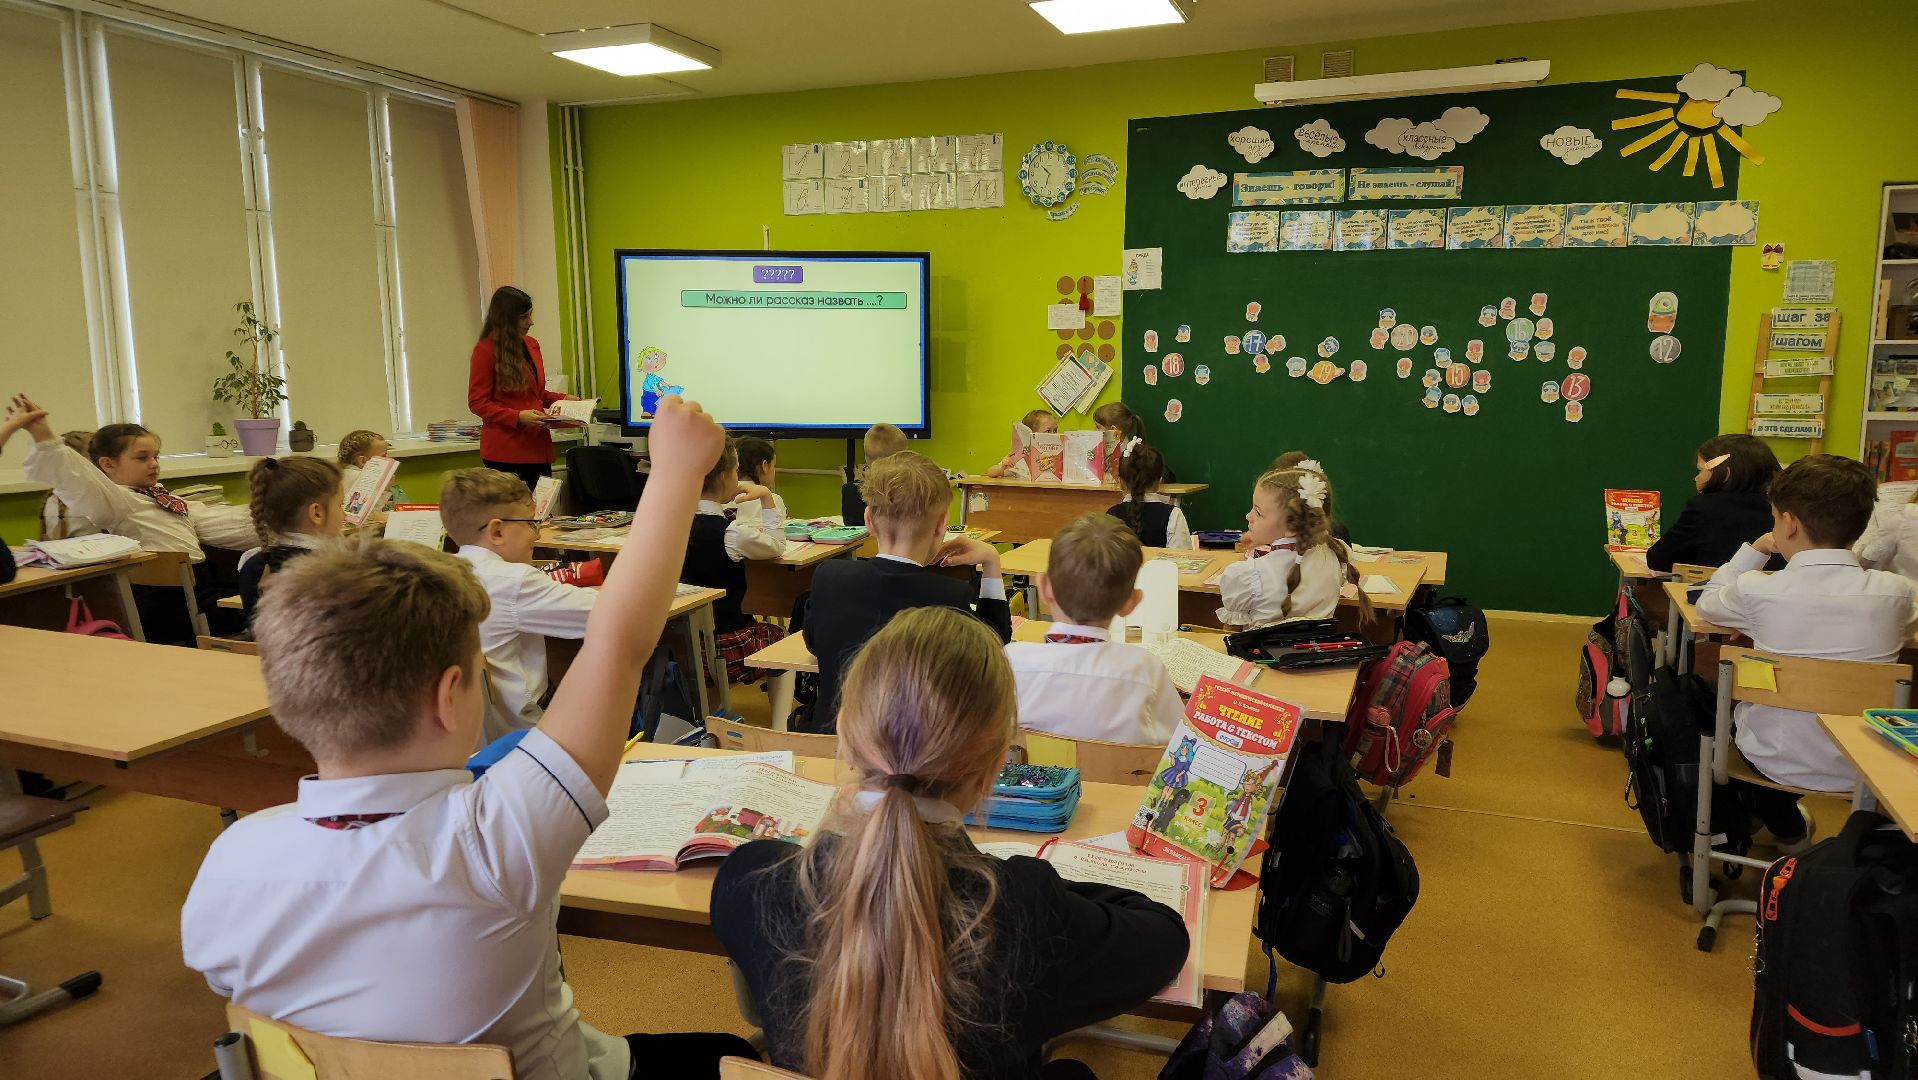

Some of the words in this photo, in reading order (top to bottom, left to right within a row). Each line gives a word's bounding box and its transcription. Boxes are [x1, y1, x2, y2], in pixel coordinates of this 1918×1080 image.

[1402, 133, 1447, 144] классные
[1546, 135, 1592, 148] НОВЫЕ
[1240, 183, 1284, 194] Знаешь
[1293, 179, 1335, 192] говори!
[1356, 180, 1371, 189] Не
[761, 268, 796, 280] ?????
[705, 293, 747, 305] Можно
[748, 296, 764, 305] ли
[766, 295, 815, 308] рассказ
[817, 296, 864, 306] назвать
[1655, 339, 1675, 362] 12
[1168, 356, 1180, 374] 18
[1567, 375, 1583, 398] 13
[1218, 704, 1264, 730] ЧТЕНИЕ
[1193, 710, 1228, 731] РАБОТА
[1227, 724, 1236, 734] С
[1235, 726, 1279, 750] ТЕКСТОМ
[1192, 797, 1208, 817] 3
